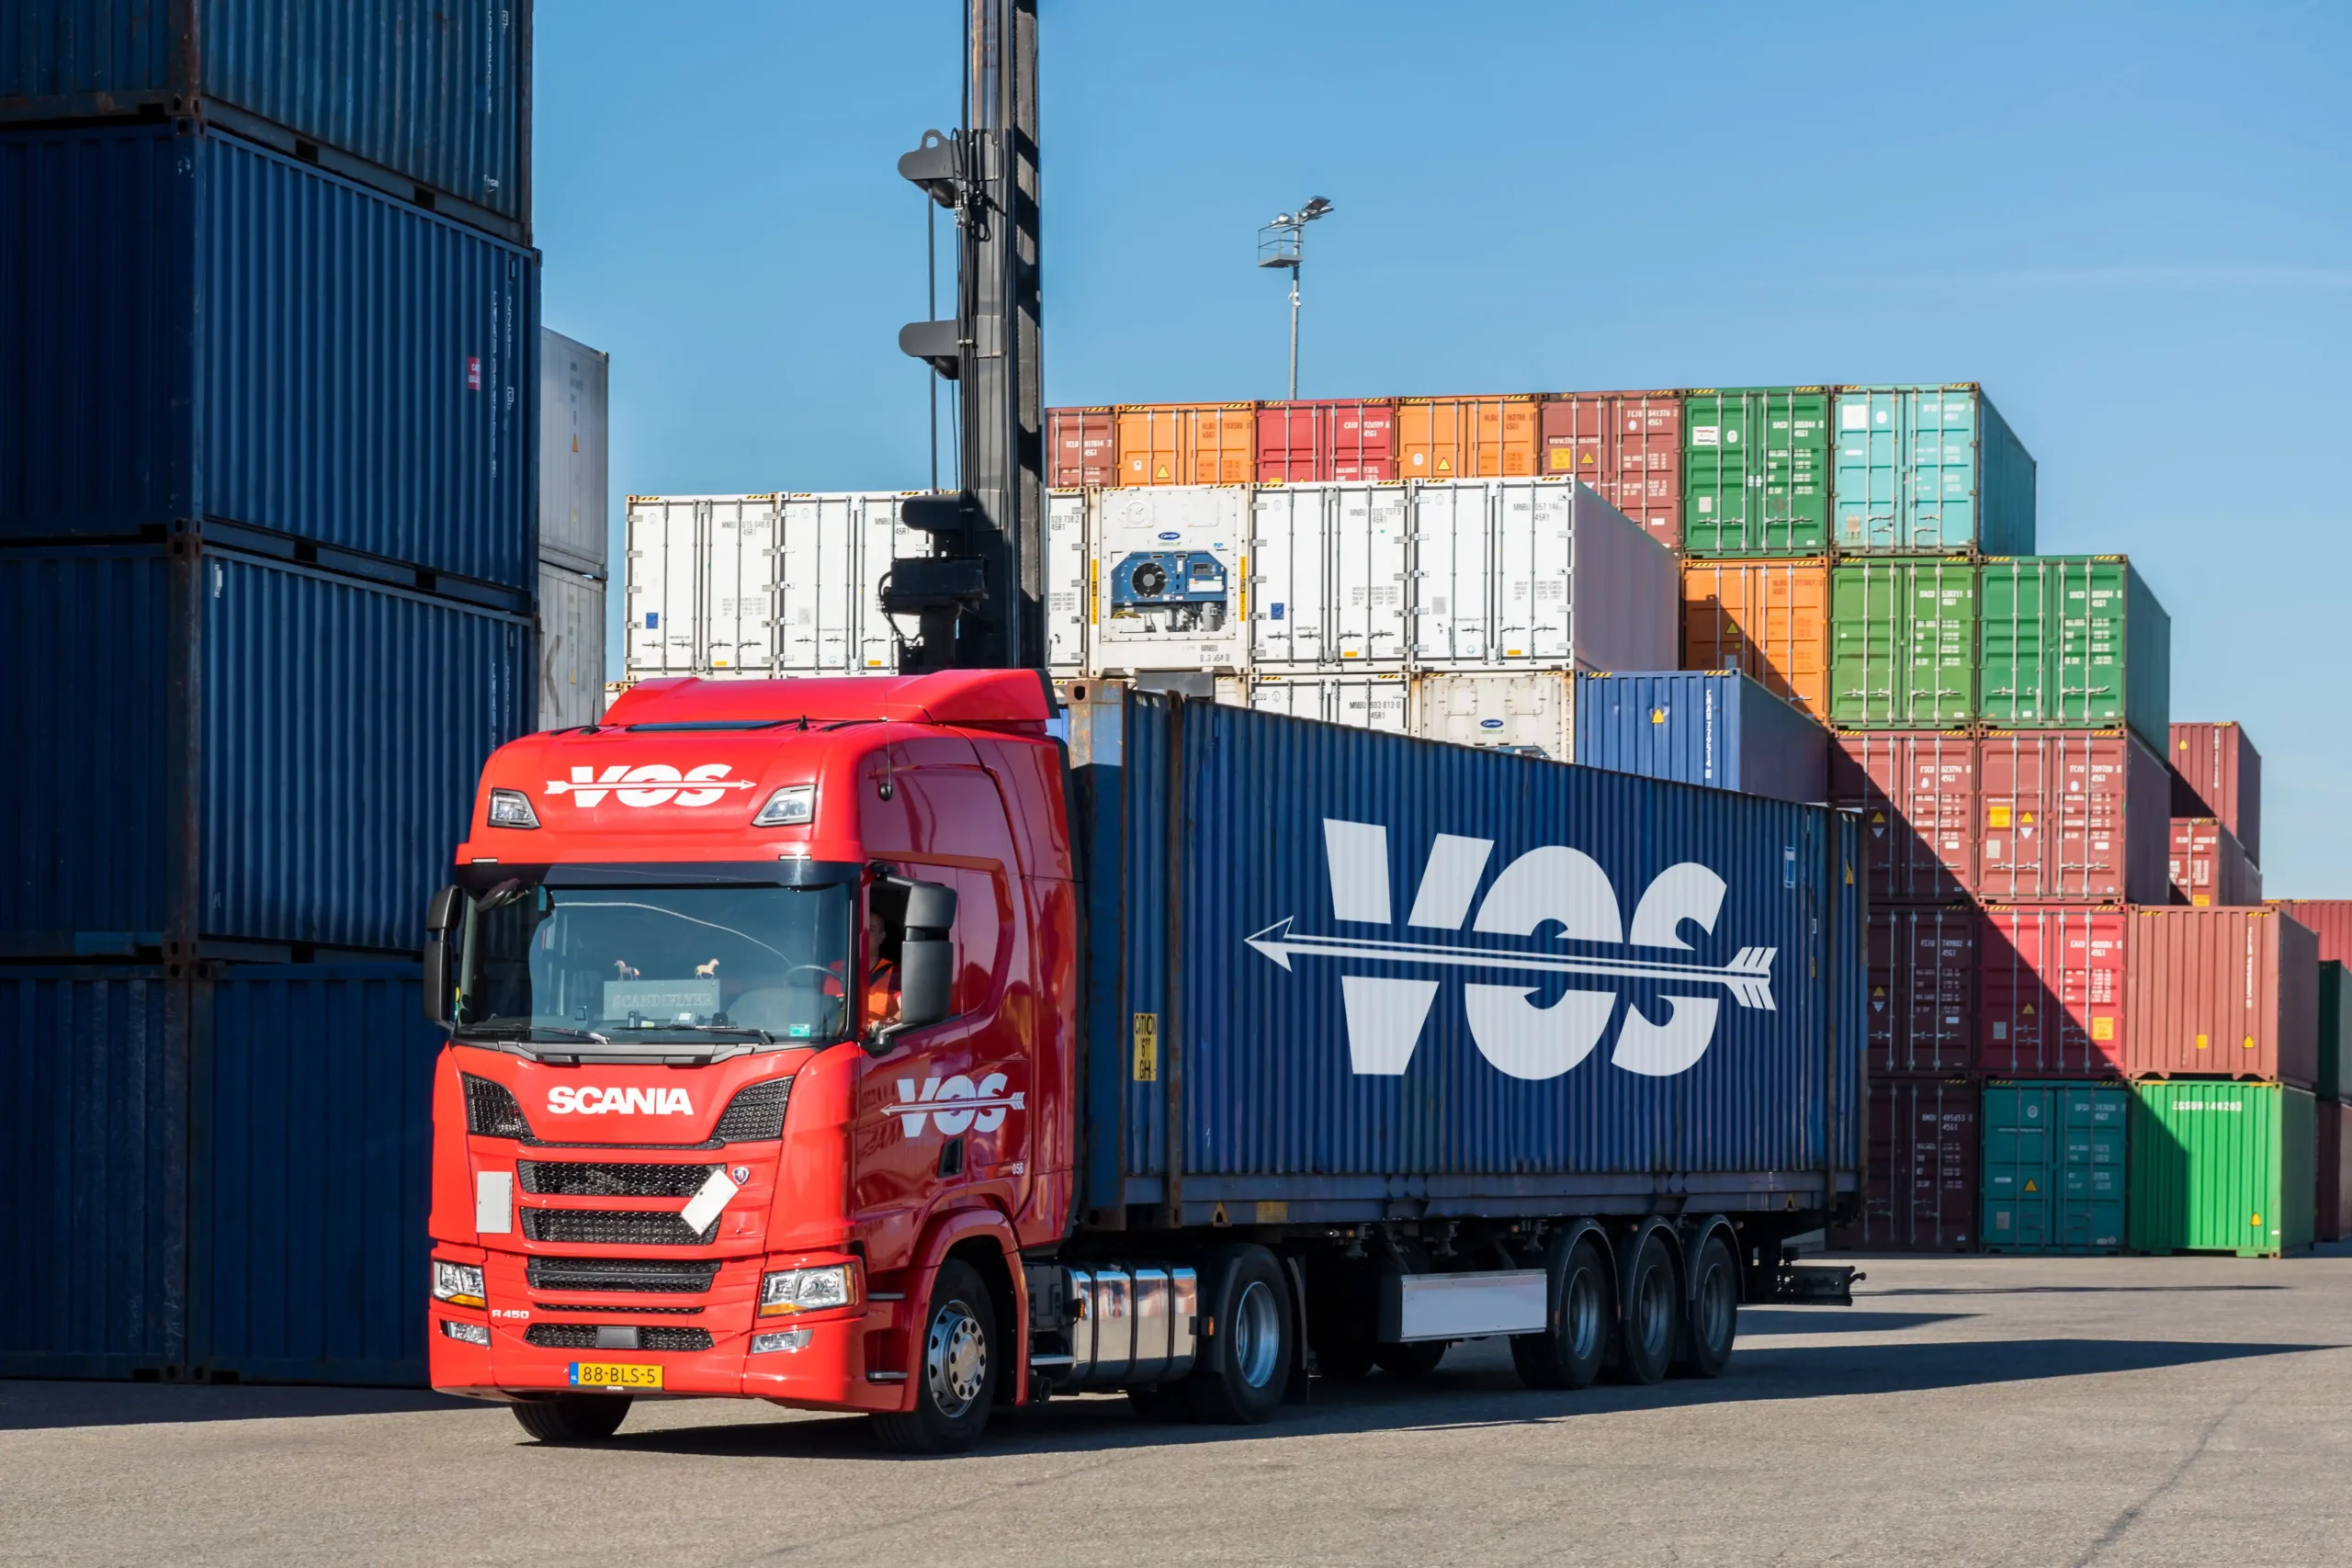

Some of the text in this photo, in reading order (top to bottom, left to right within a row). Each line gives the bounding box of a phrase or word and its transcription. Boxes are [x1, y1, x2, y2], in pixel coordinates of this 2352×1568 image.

[1350, 701, 1366, 709] MNBU
[571, 763, 732, 807] VOS
[1323, 817, 1727, 1080] VOS
[1967, 940, 1973, 948] 4
[547, 1086, 694, 1115] SCANIA
[897, 1072, 1007, 1138] VOS
[503, 1310, 529, 1319] 450
[583, 1366, 655, 1383] 88-BLS-5
